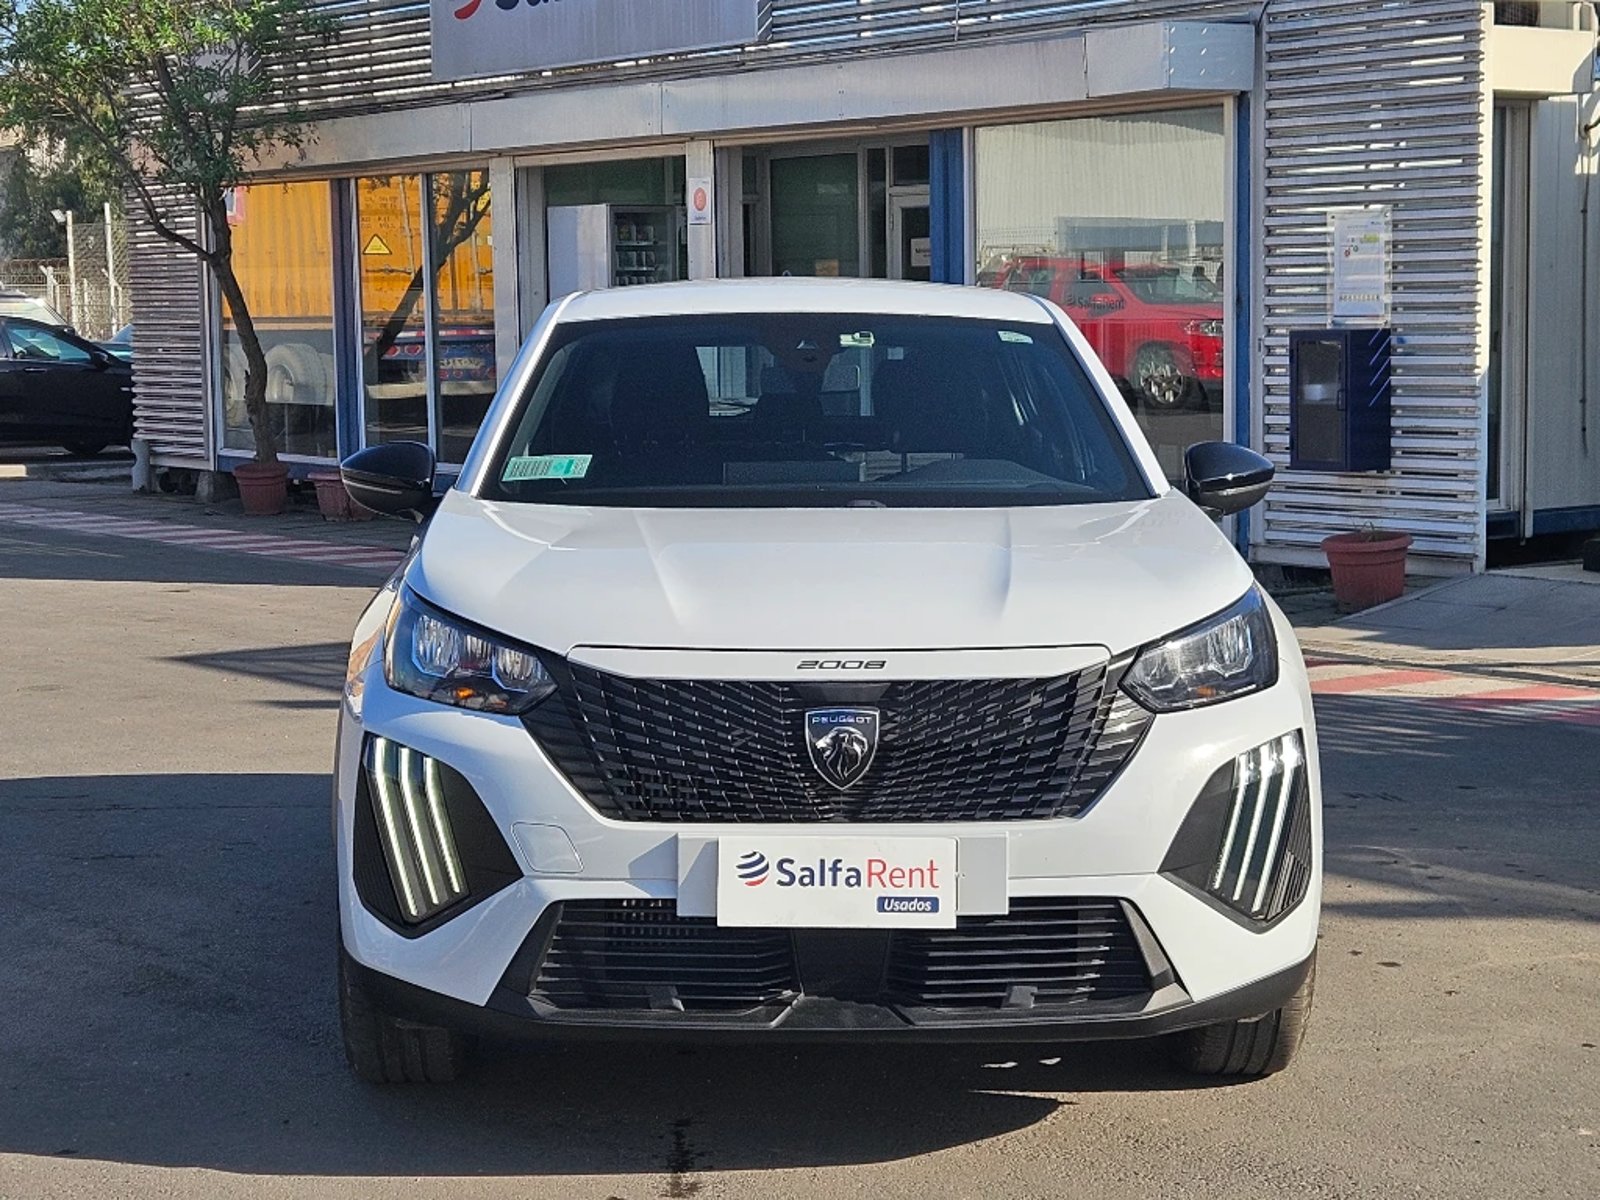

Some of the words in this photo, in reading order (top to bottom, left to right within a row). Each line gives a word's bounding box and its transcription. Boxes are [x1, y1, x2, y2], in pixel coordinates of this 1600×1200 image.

[797, 660, 887, 670] 2008
[812, 715, 873, 724] PEUGEOT
[776, 858, 939, 888] SalfaRent
[884, 898, 931, 911] Usados
